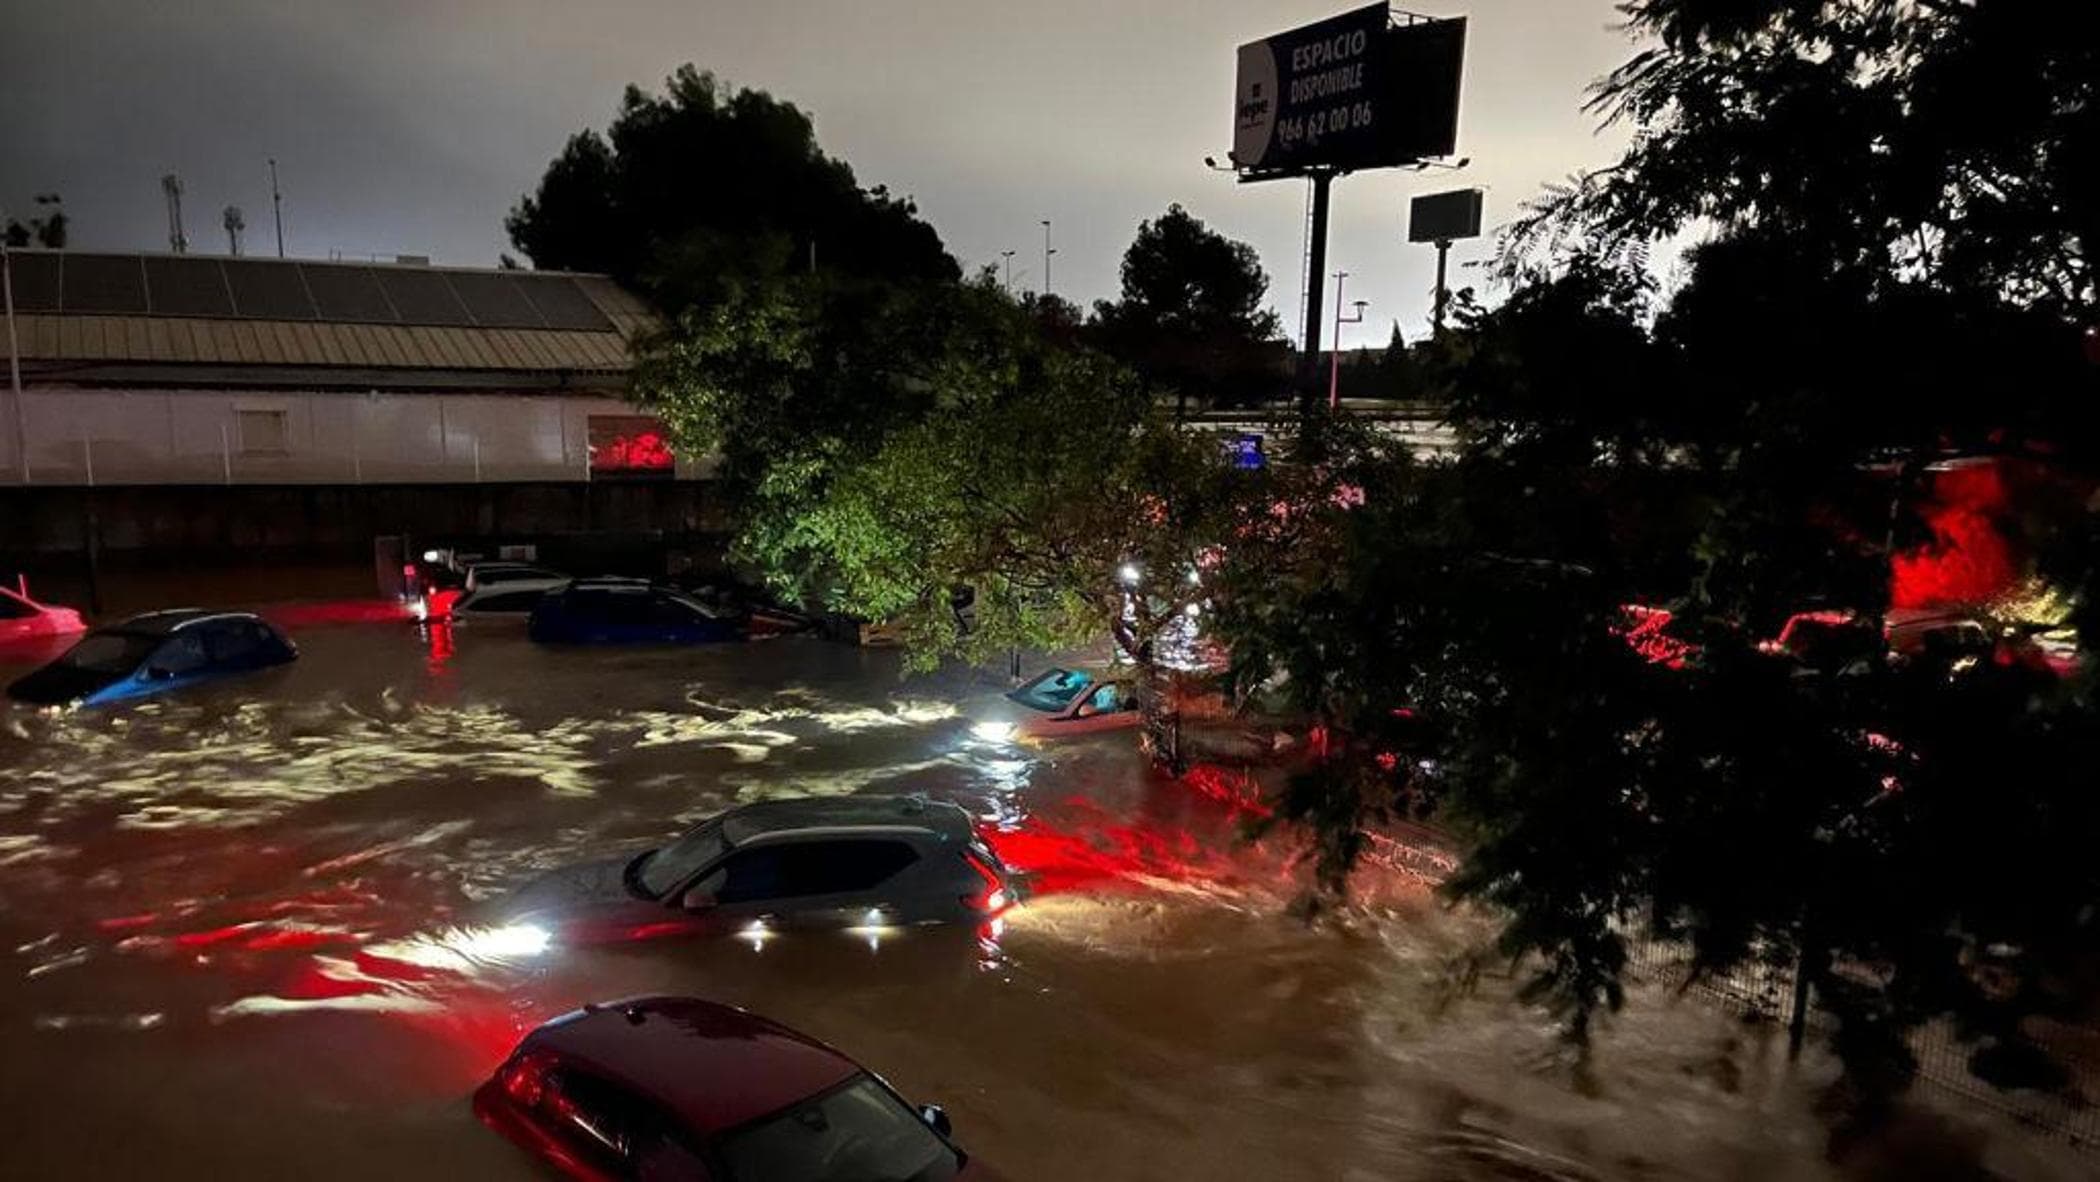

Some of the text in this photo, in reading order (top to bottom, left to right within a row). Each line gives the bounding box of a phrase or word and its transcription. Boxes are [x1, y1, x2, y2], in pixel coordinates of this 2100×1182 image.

[1292, 29, 1366, 72] ESPACIO
[1290, 63, 1363, 104] DISPONIBLE
[1279, 100, 1372, 143] 966 62 00 06
